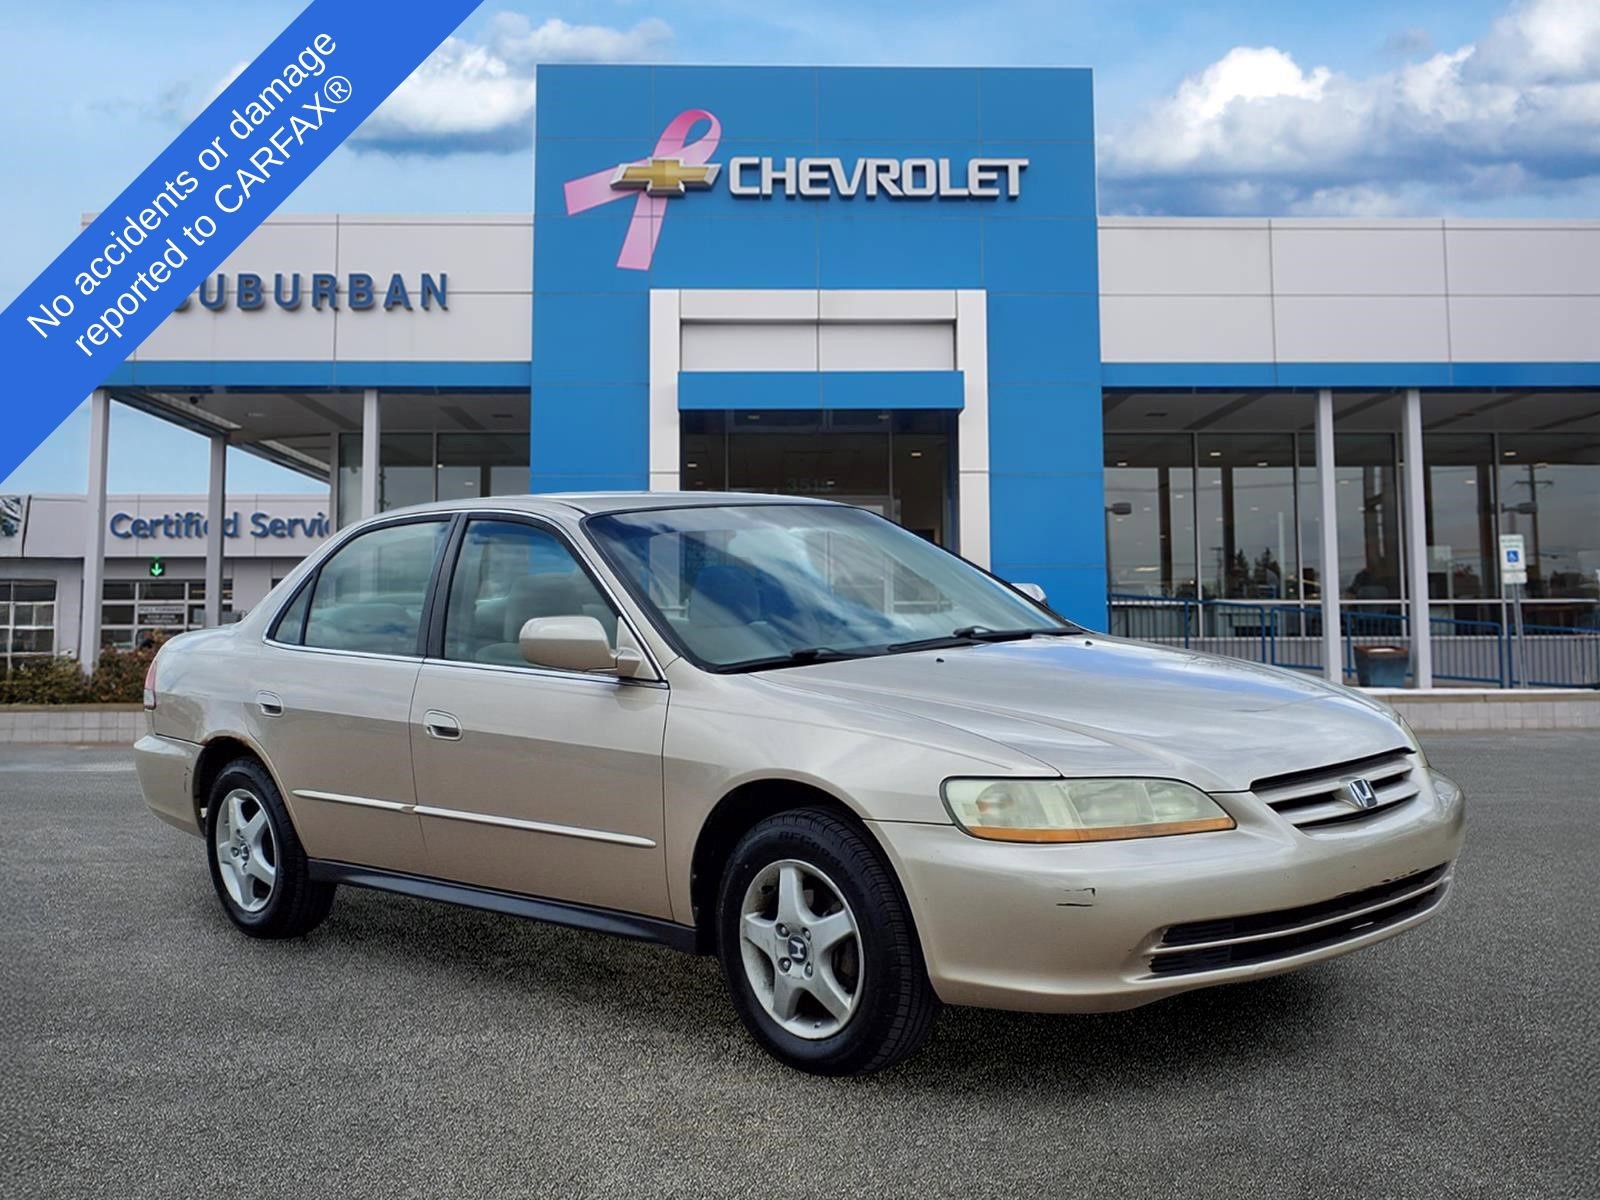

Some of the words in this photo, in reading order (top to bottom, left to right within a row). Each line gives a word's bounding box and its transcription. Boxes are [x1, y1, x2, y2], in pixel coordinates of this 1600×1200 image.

[729, 156, 1029, 196] CHEVROLET
[174, 273, 448, 312] UBURBAN
[250, 512, 330, 538] Servi
